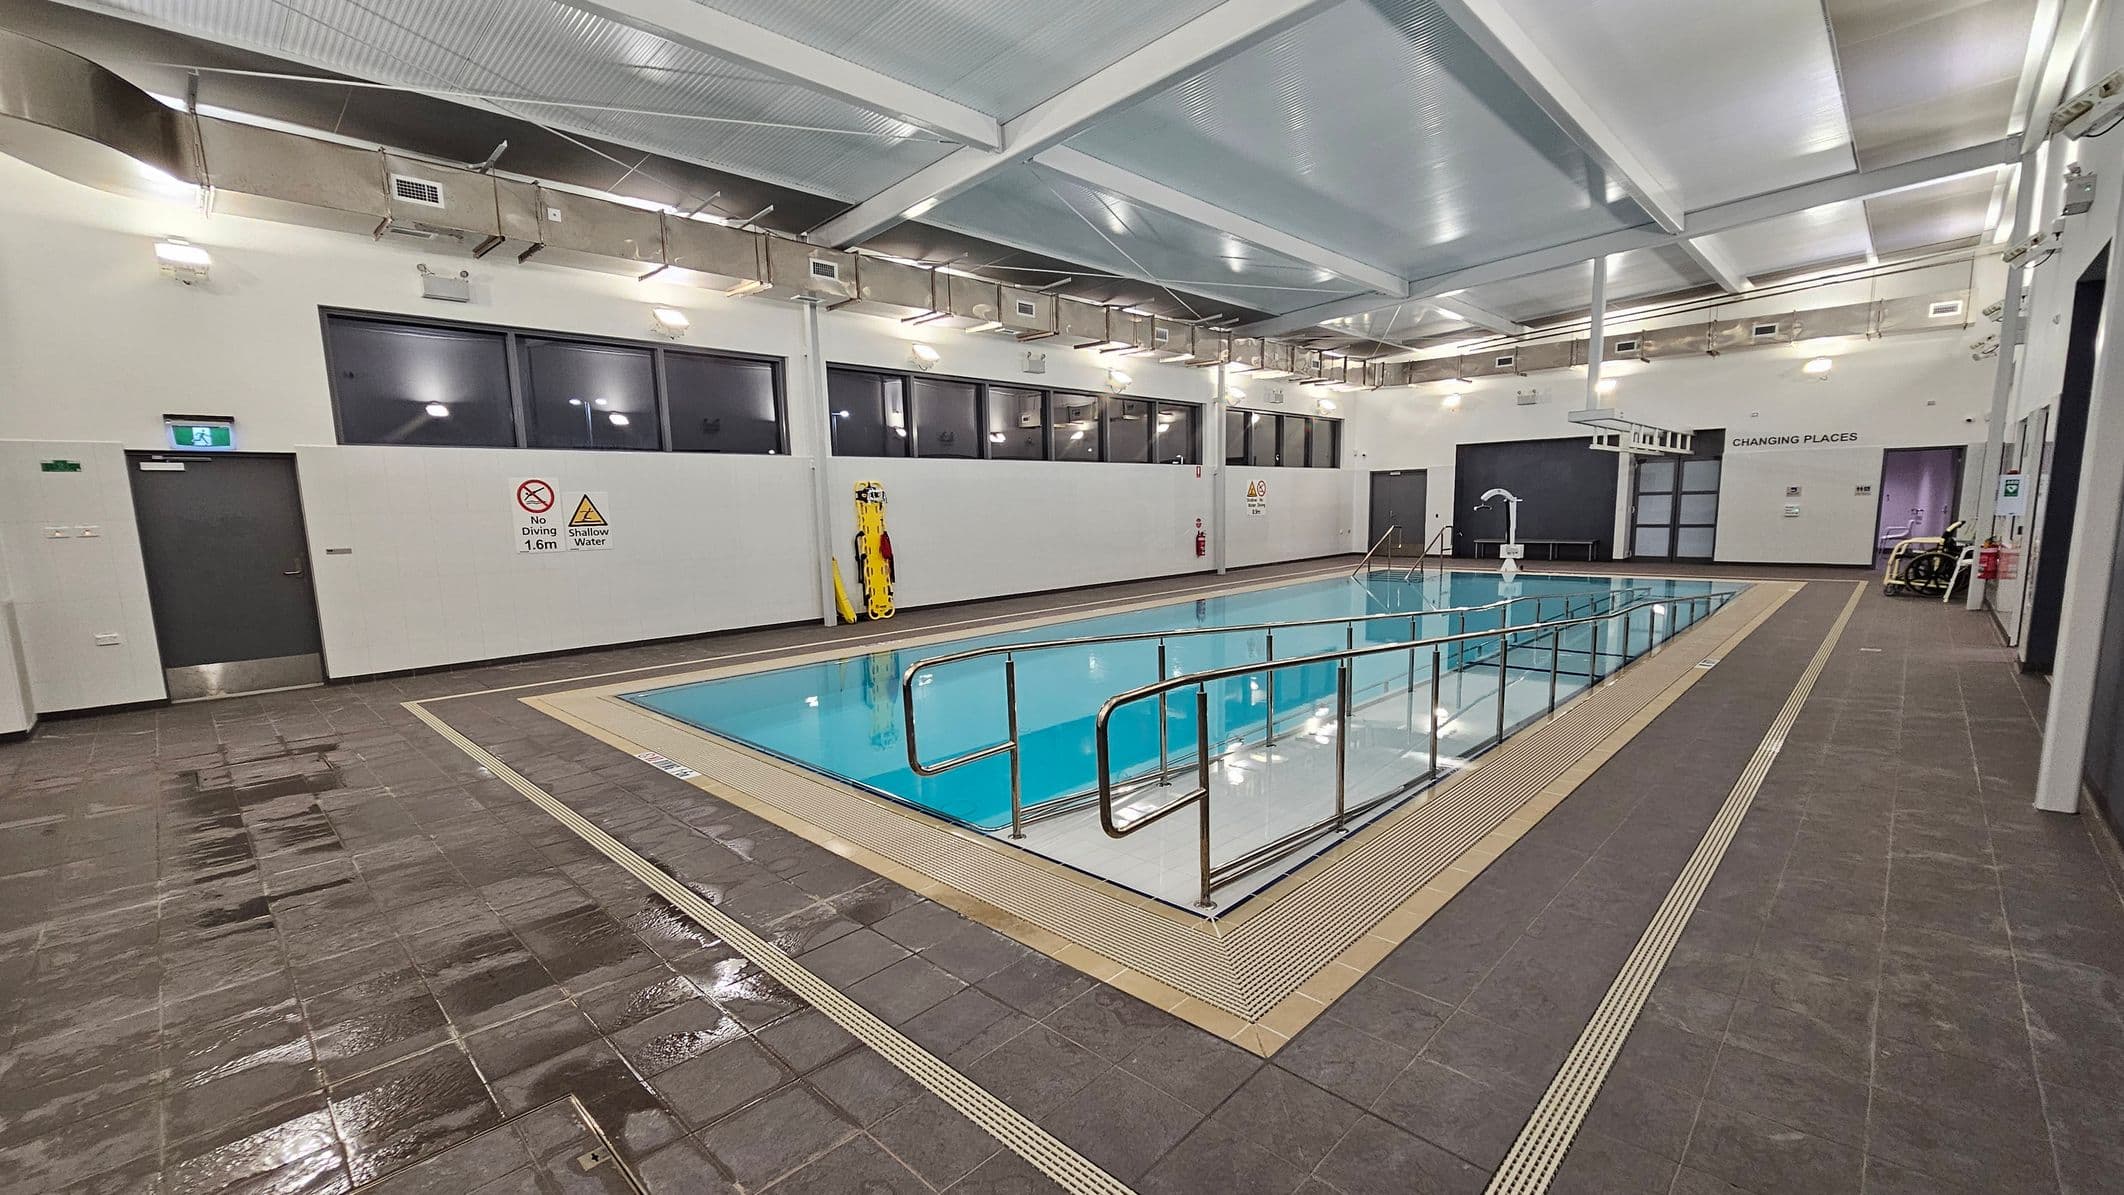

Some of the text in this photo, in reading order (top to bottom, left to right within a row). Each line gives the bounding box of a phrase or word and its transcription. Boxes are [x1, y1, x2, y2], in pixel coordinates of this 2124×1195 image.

[1732, 432, 1858, 447] CHANGING PLACES
[530, 516, 546, 524] No
[522, 526, 557, 537] Diving
[568, 528, 609, 537] Shallow
[525, 539, 557, 550] 1.6m
[574, 538, 605, 546] Water
